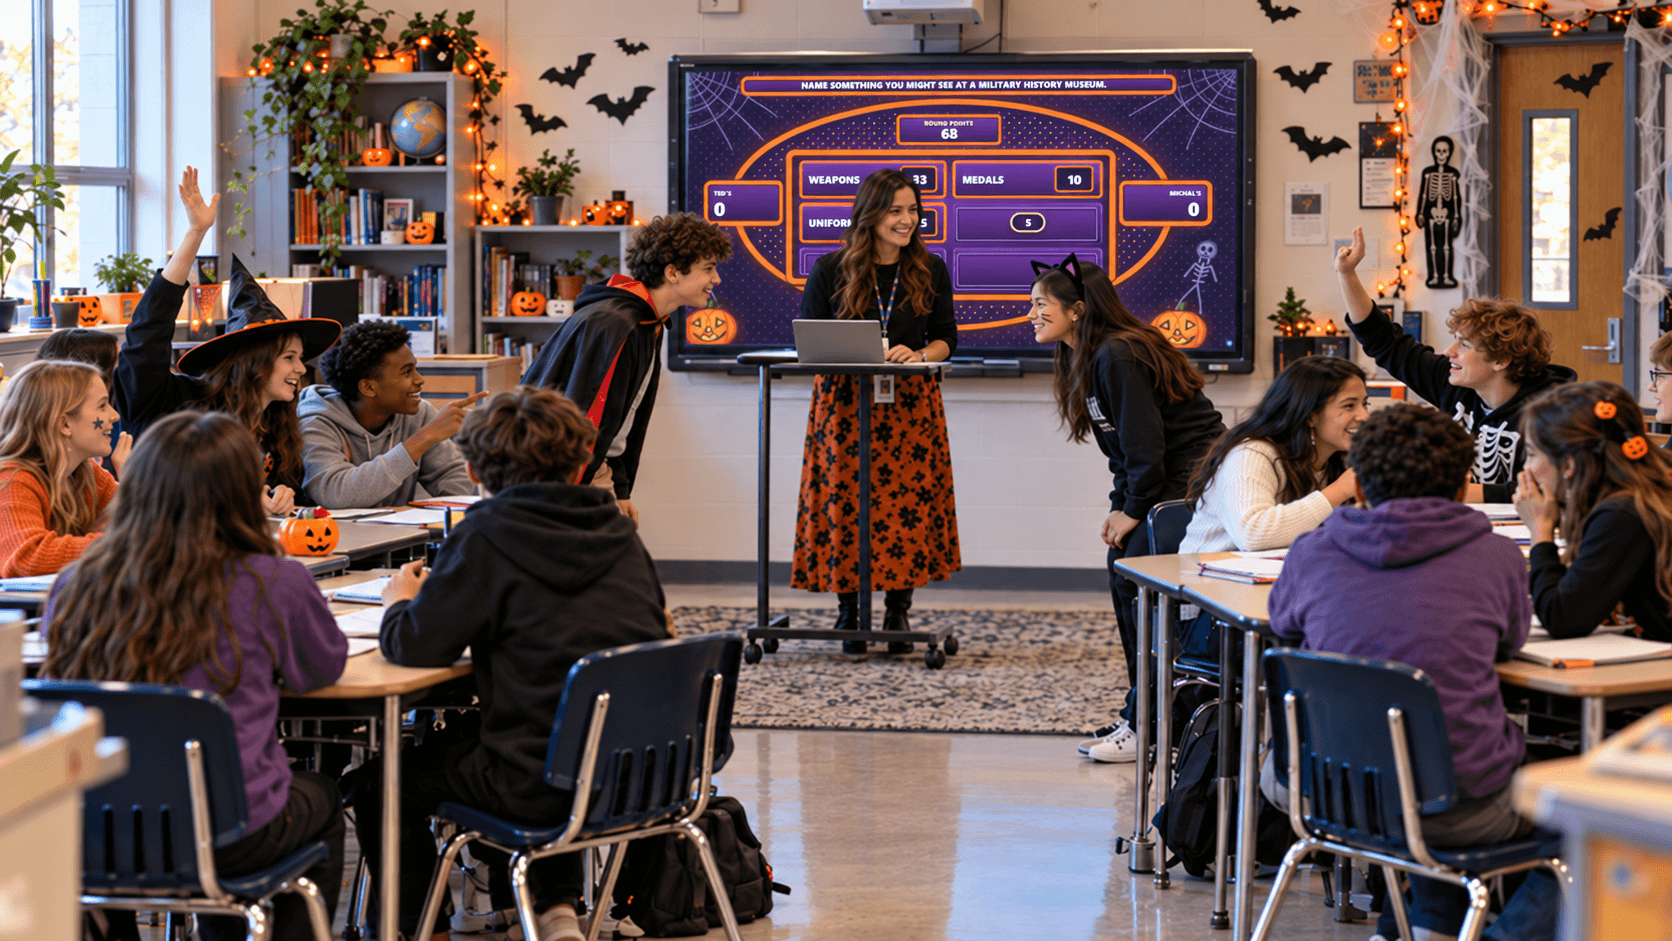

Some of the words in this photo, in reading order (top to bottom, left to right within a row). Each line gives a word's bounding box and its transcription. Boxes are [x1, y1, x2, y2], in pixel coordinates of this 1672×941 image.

[801, 81, 828, 89] NAME
[830, 81, 883, 89] SOMETHING
[885, 81, 904, 89] YOU
[906, 81, 936, 89] MIGHT
[938, 81, 954, 89] SEE
[955, 81, 968, 89] AT
[969, 81, 976, 89] A
[978, 81, 1021, 89] MILITARY
[1023, 81, 1062, 89] HISTORY
[1064, 81, 1107, 89] MUSEUM.
[941, 128, 958, 140] 68
[808, 175, 860, 185] WEAPONS
[912, 174, 928, 185] 33
[962, 175, 1004, 185] MEDALS
[1067, 174, 1082, 185] 10
[713, 202, 726, 217] 0
[1187, 202, 1200, 217] 0
[920, 218, 928, 228] 5
[1024, 218, 1032, 228] 5
